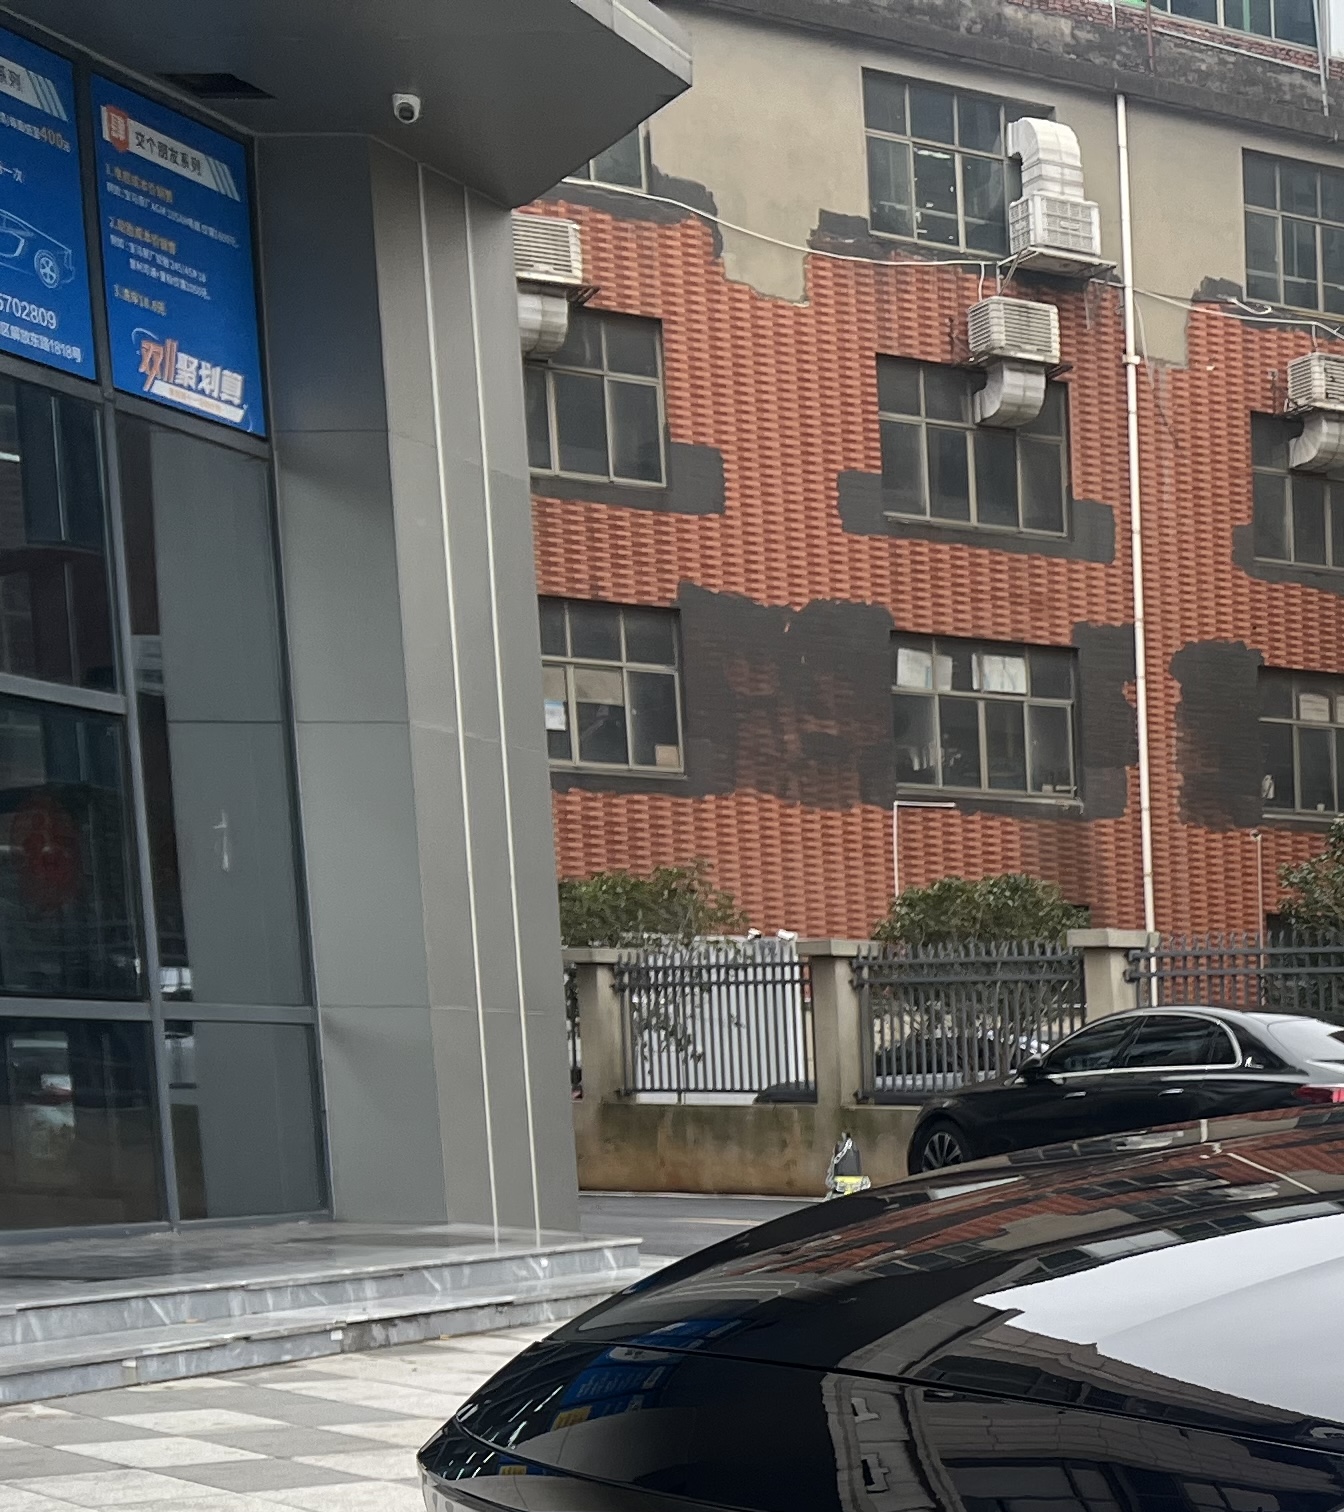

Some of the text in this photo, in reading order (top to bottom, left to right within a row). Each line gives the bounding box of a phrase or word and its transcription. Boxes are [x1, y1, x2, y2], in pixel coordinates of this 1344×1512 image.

[134, 130, 203, 177] 交个朋友系列
